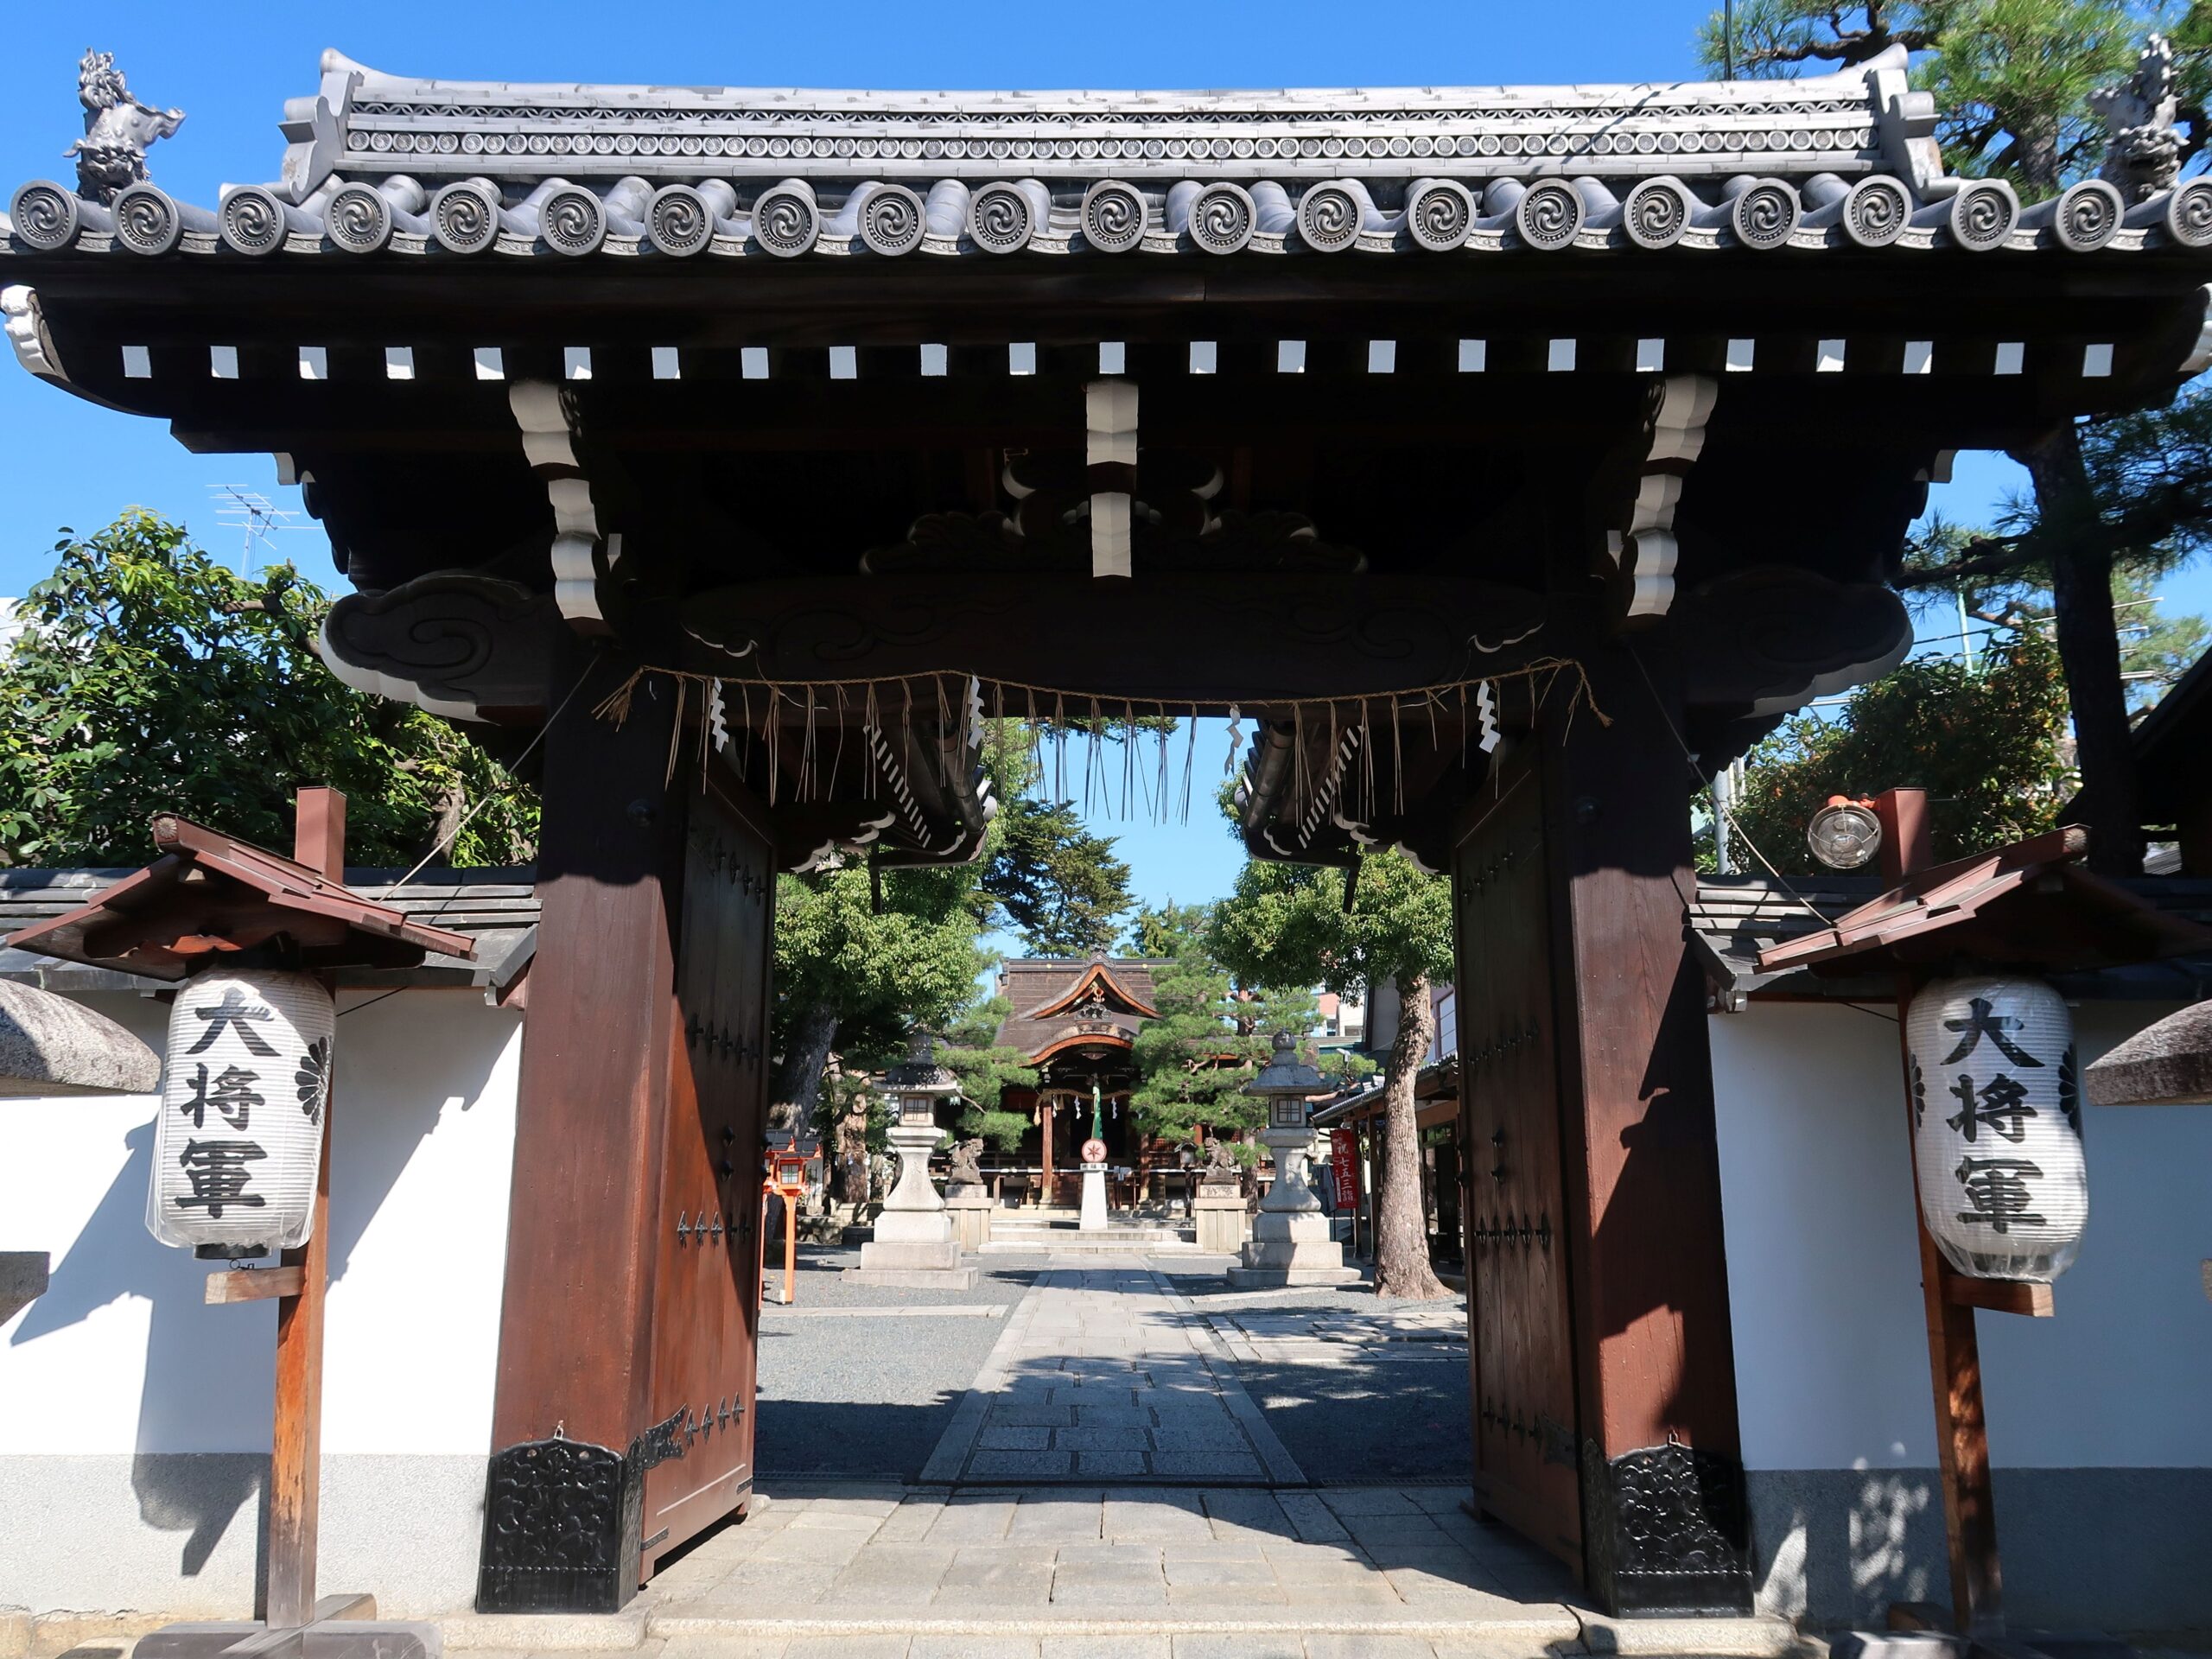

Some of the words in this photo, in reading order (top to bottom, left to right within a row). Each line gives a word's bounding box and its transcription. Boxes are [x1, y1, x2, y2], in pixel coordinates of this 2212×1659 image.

[175, 987, 282, 1219] 大将軍
[1940, 998, 2045, 1234] 大将軍
